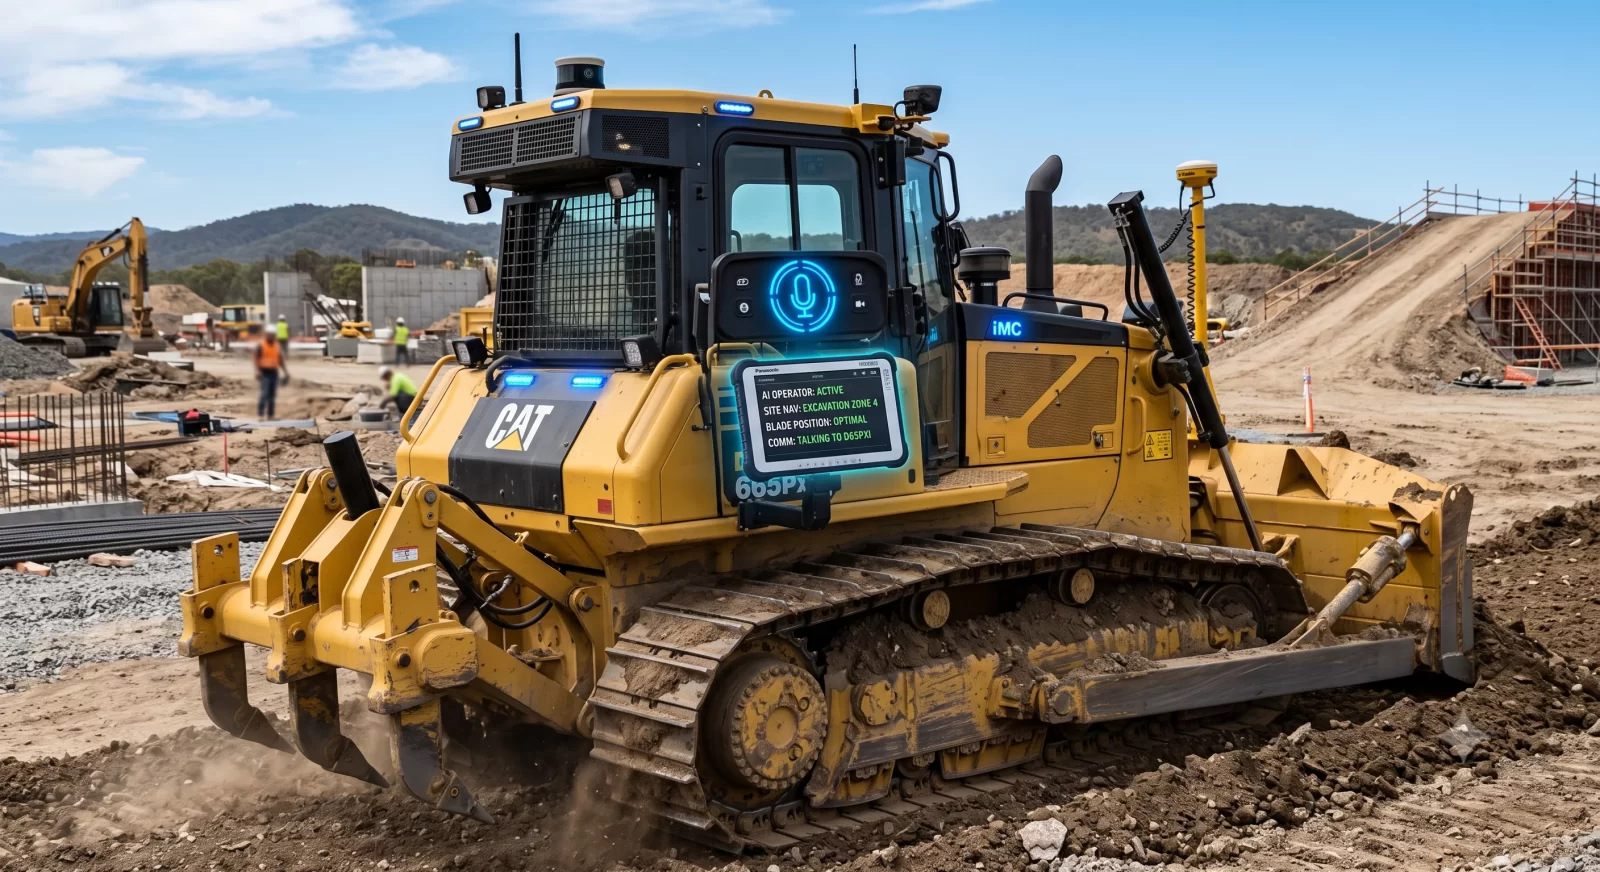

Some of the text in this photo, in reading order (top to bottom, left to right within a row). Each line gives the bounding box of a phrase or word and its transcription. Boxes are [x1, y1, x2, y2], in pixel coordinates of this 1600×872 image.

[992, 320, 1022, 336] iMC
[762, 385, 844, 400] AI OPERATOR: ACTIVE
[763, 398, 878, 415] SITE NAV: EXCAVATION ZONE 4
[485, 403, 554, 451] CAT
[765, 415, 868, 431] BLADE POSITION: OPTIMAL
[768, 436, 796, 447] COMM:
[797, 433, 831, 445] TALKING
[831, 433, 842, 442] TO
